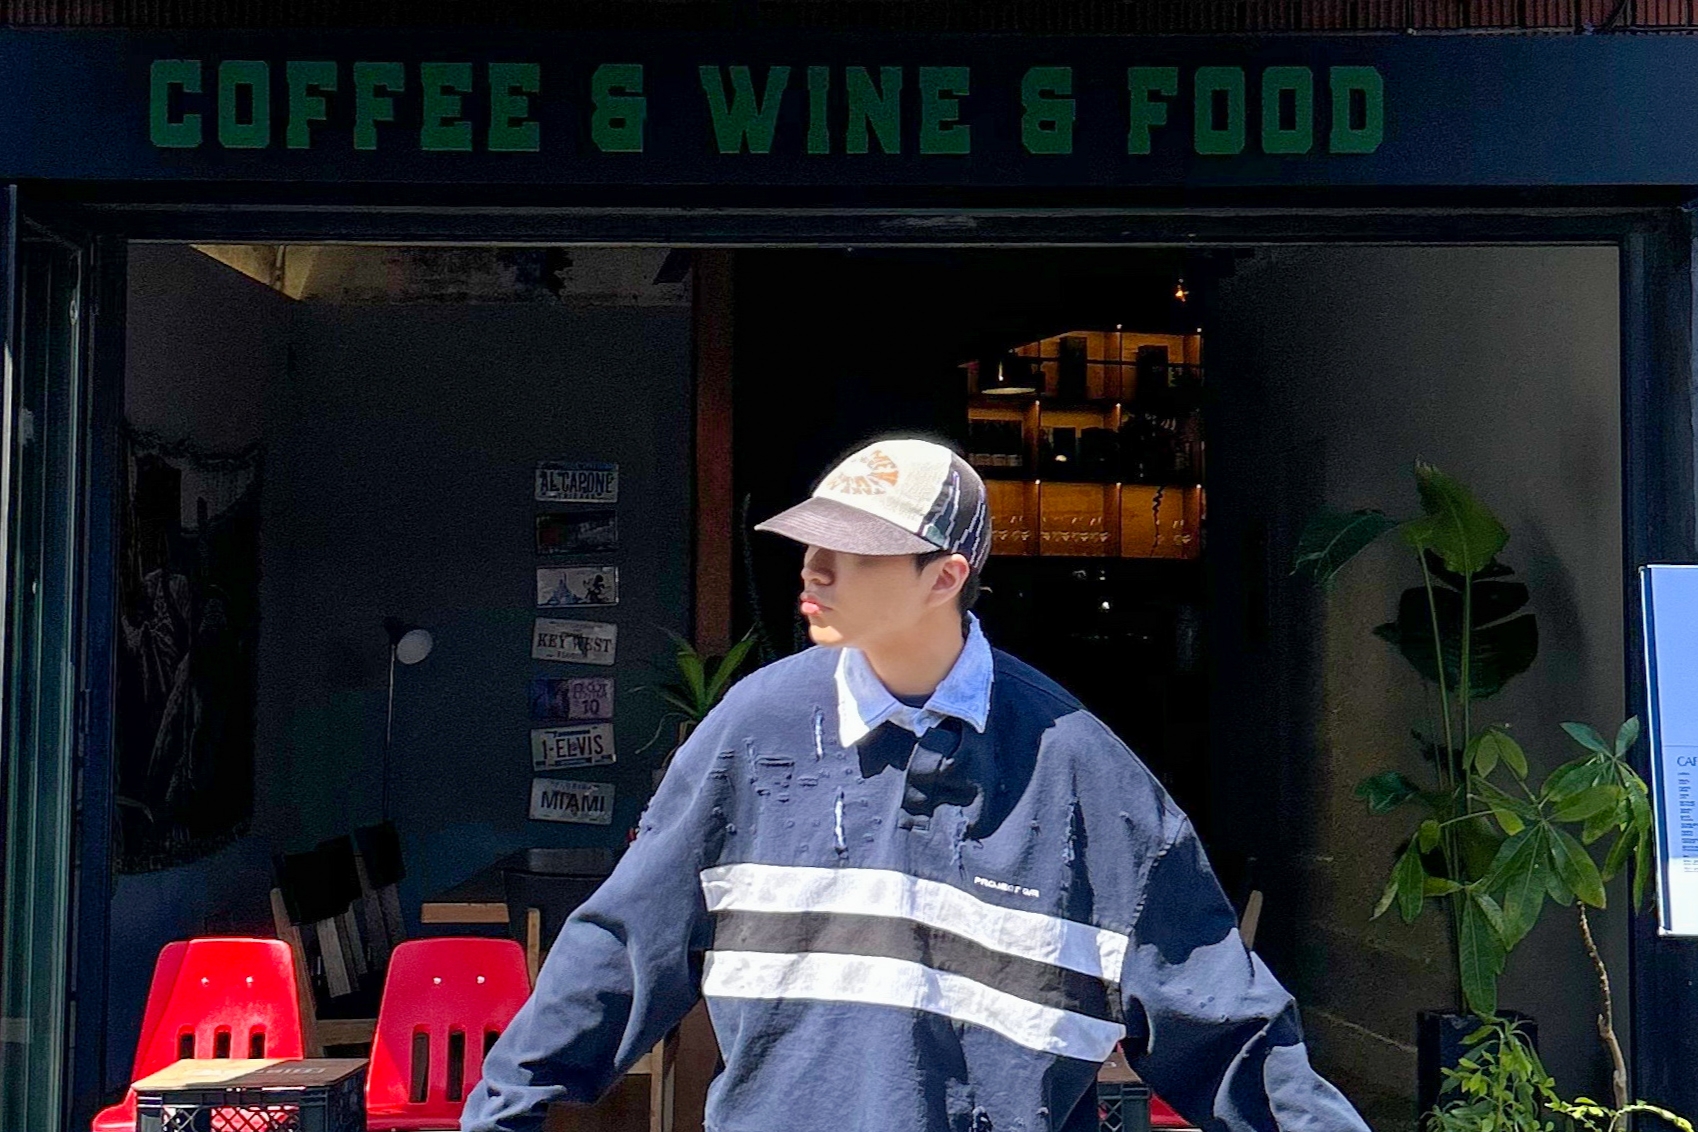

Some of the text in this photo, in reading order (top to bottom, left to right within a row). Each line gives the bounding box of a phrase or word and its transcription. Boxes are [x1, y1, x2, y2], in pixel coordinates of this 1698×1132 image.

[150, 60, 1386, 156] COFFEE & WINE & FOOD
[562, 472, 614, 493] CAPONE
[537, 633, 568, 649] KEY
[541, 790, 605, 813] MIAMI
